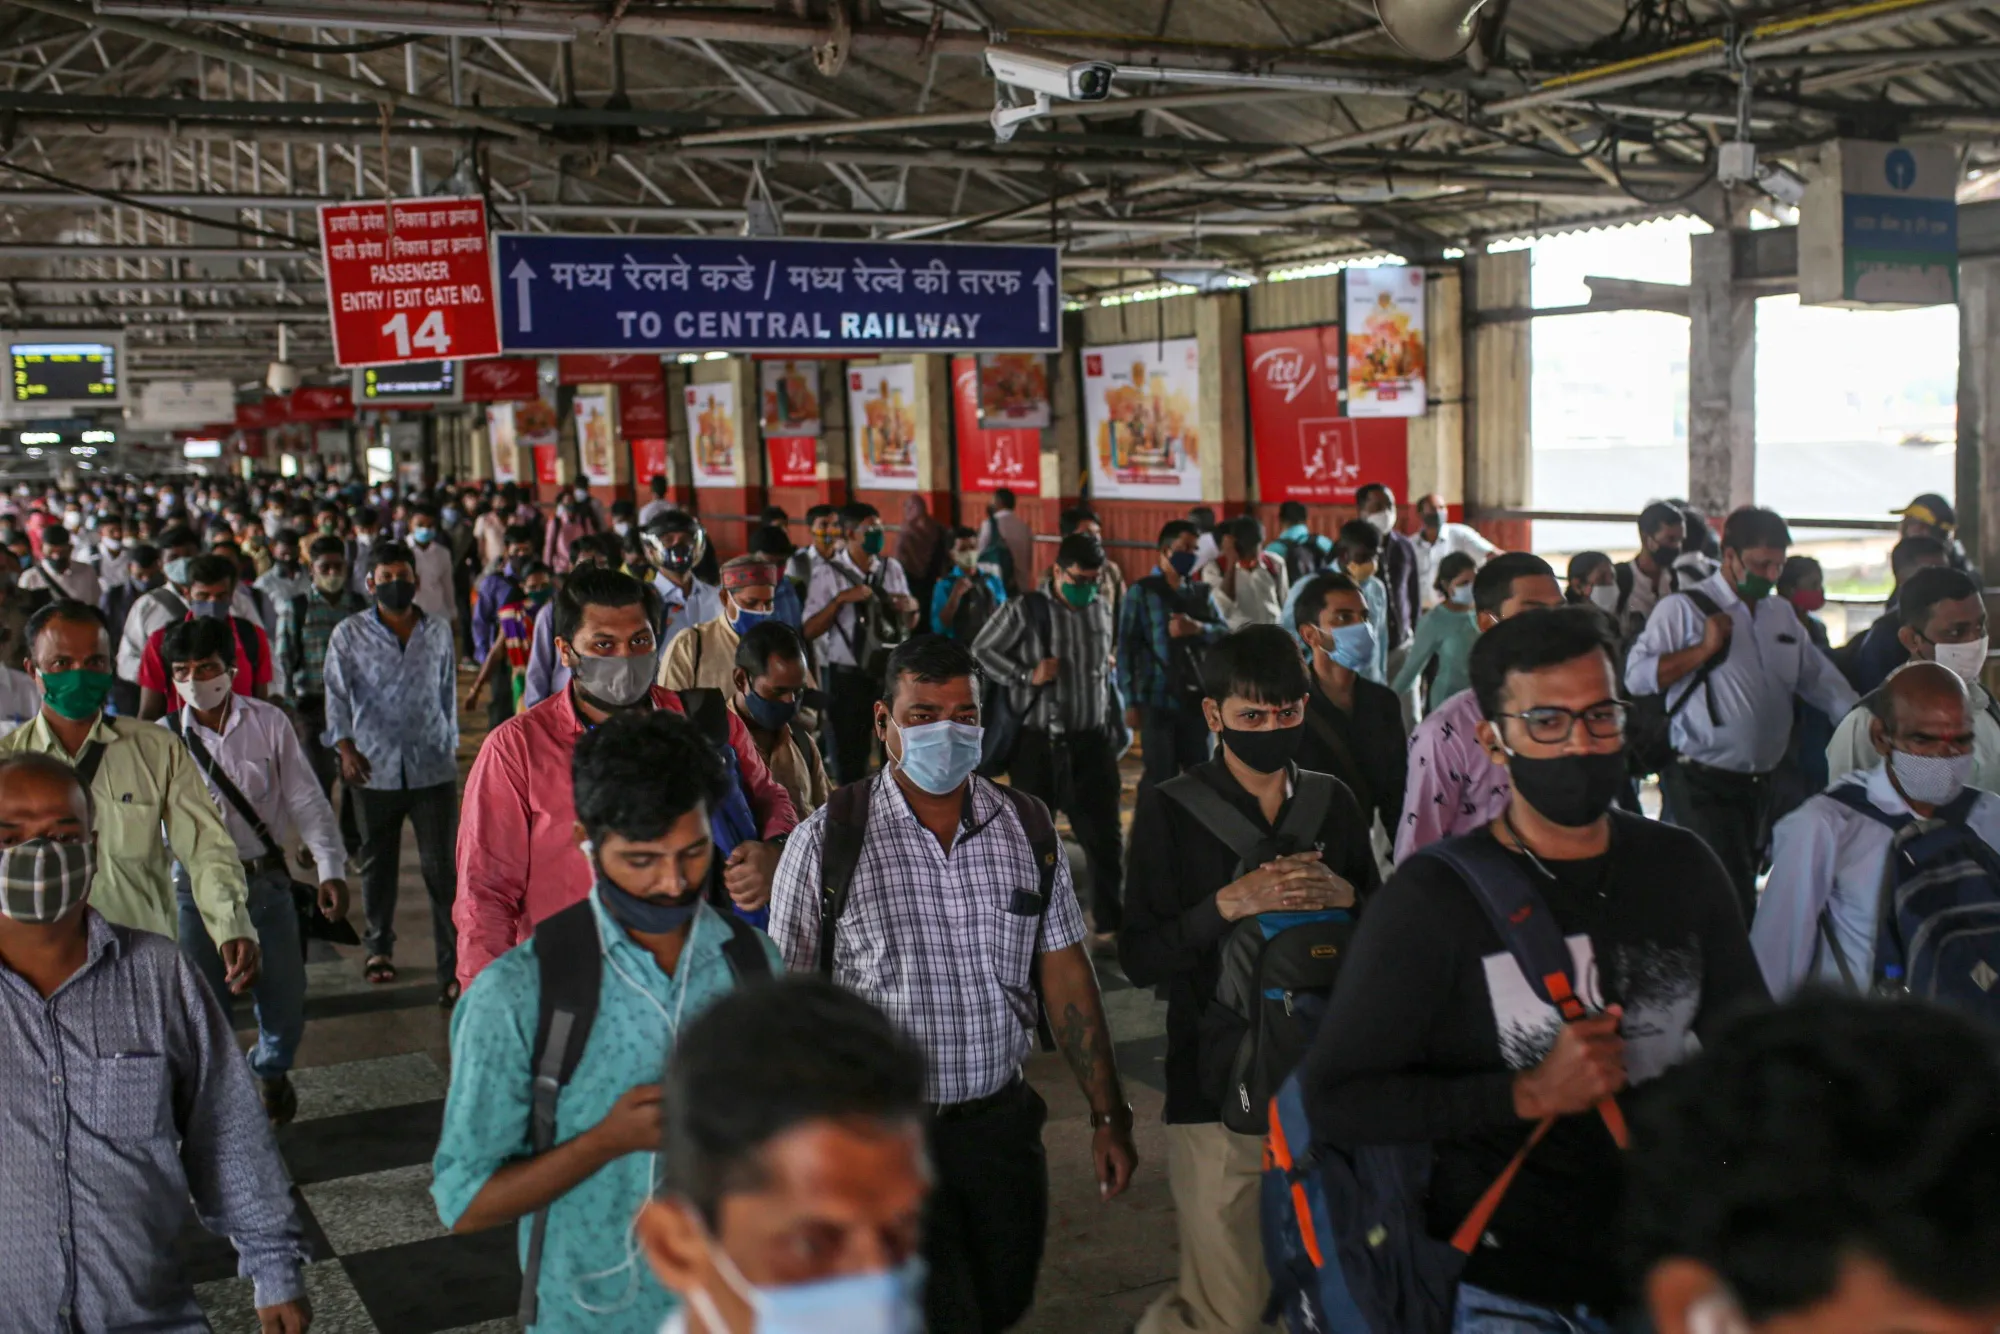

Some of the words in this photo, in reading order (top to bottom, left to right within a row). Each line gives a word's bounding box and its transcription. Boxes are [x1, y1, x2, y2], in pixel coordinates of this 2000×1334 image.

[370, 261, 450, 284] PASSENGER
[549, 263, 615, 291] मध्य
[622, 252, 691, 291] रेलवे
[698, 254, 756, 292] कडे
[787, 266, 845, 293] मध्य
[852, 257, 906, 294] रेल्वे
[912, 258, 951, 294] की
[957, 269, 1022, 295] तरफ
[340, 290, 384, 312] ENTRY
[393, 288, 422, 308] EXIT
[425, 286, 460, 306] GATE
[461, 284, 485, 304] NO.
[381, 309, 452, 357] 14
[616, 311, 662, 339] TO
[674, 311, 831, 339] CENTRAL
[841, 311, 982, 339] RAILWAY
[1266, 353, 1304, 383] itel
